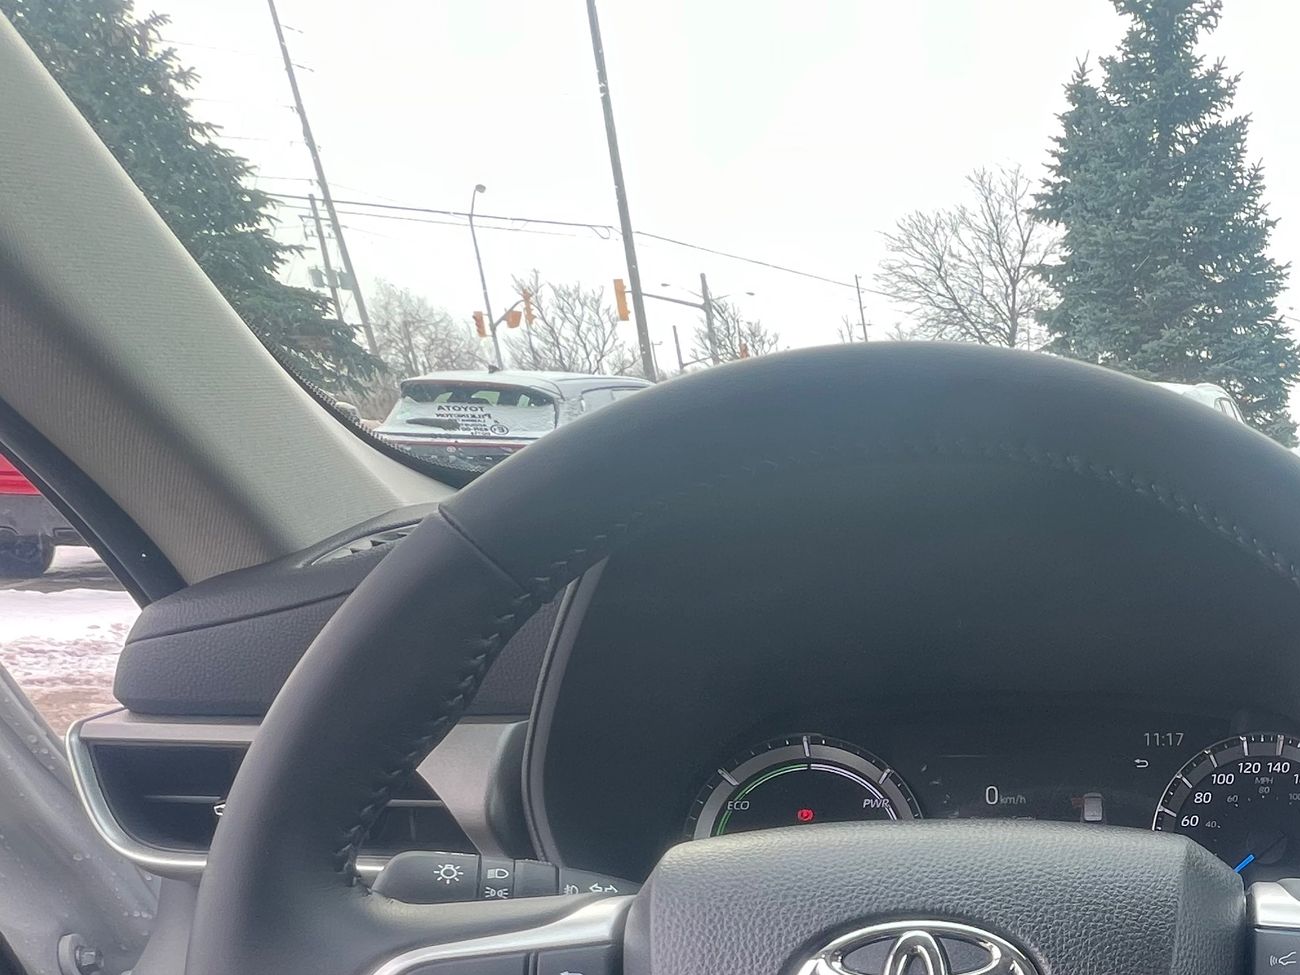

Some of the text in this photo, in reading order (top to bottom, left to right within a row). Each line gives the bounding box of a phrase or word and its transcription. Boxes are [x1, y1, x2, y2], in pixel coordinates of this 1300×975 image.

[1144, 732, 1184, 747] 11:17
[1238, 762, 1261, 774] 120
[1266, 762, 1290, 774] 140
[1212, 774, 1234, 785] 100
[1254, 776, 1274, 784] MPH
[986, 786, 1026, 804] 0 km/h
[1258, 786, 1270, 794] 80
[862, 799, 890, 808] PWR
[1194, 792, 1212, 804] 80
[1226, 795, 1238, 803] 60
[727, 800, 750, 810] ECO
[1182, 816, 1199, 827] 60
[1206, 820, 1217, 828] 40
